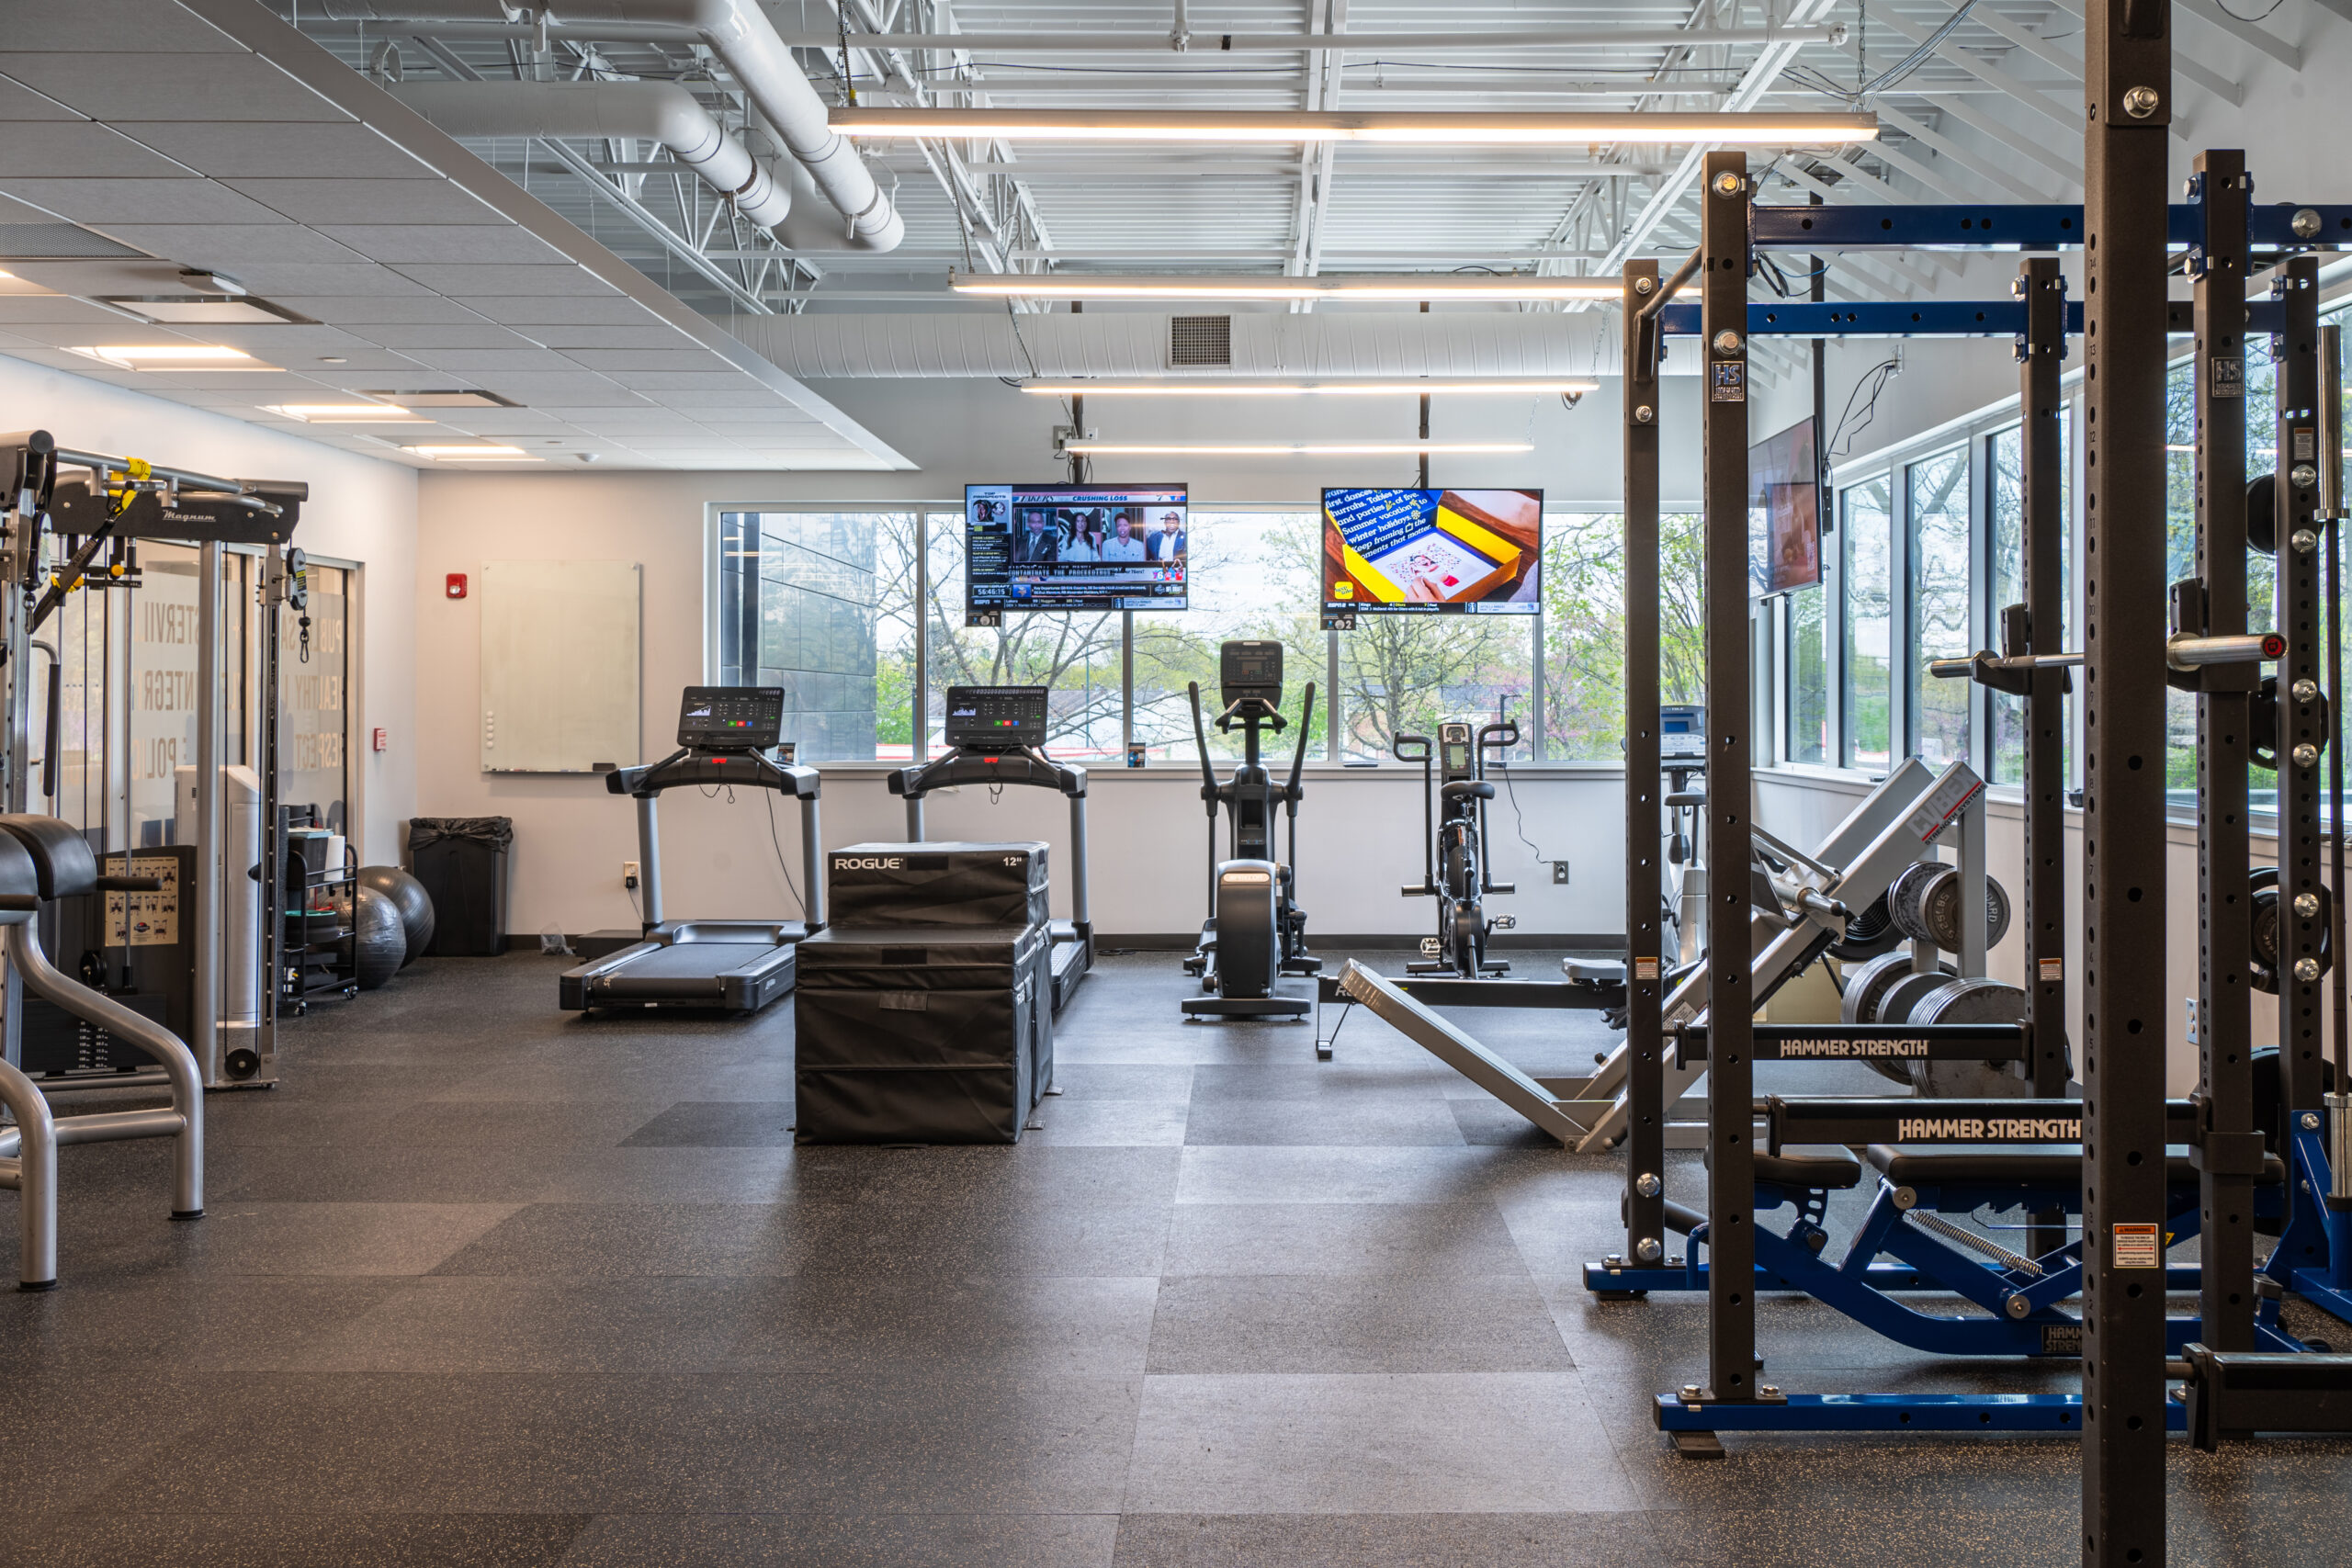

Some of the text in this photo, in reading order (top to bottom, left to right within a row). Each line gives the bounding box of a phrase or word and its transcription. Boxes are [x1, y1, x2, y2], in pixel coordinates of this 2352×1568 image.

[1715, 365, 1740, 385] HS
[1329, 501, 1367, 517] hurrahs.
[1366, 491, 1393, 504] Tables
[1344, 490, 1373, 502] dances
[163, 510, 216, 522] Magnum
[1337, 492, 1419, 525] and parties of five.
[1341, 517, 1378, 536] Summer
[1379, 505, 1412, 520] vacation
[1349, 515, 1412, 544] winter holidays.
[1374, 527, 1404, 545] framing
[1414, 518, 1427, 527] the
[1361, 525, 1432, 558] oments that matter.
[1345, 619, 1351, 629] 2
[1905, 770, 1980, 839] CYBEX
[1924, 784, 1986, 846] STRENGTH SYSTEMS
[834, 858, 901, 870] ROGUE
[1003, 856, 1022, 867] 12"
[1780, 1039, 1928, 1058] HAMMER STRENGTH
[1898, 1118, 2082, 1142] HAMMER STRENGTH
[2049, 1326, 2083, 1340] HAMM
[2045, 1339, 2083, 1351] STREN
